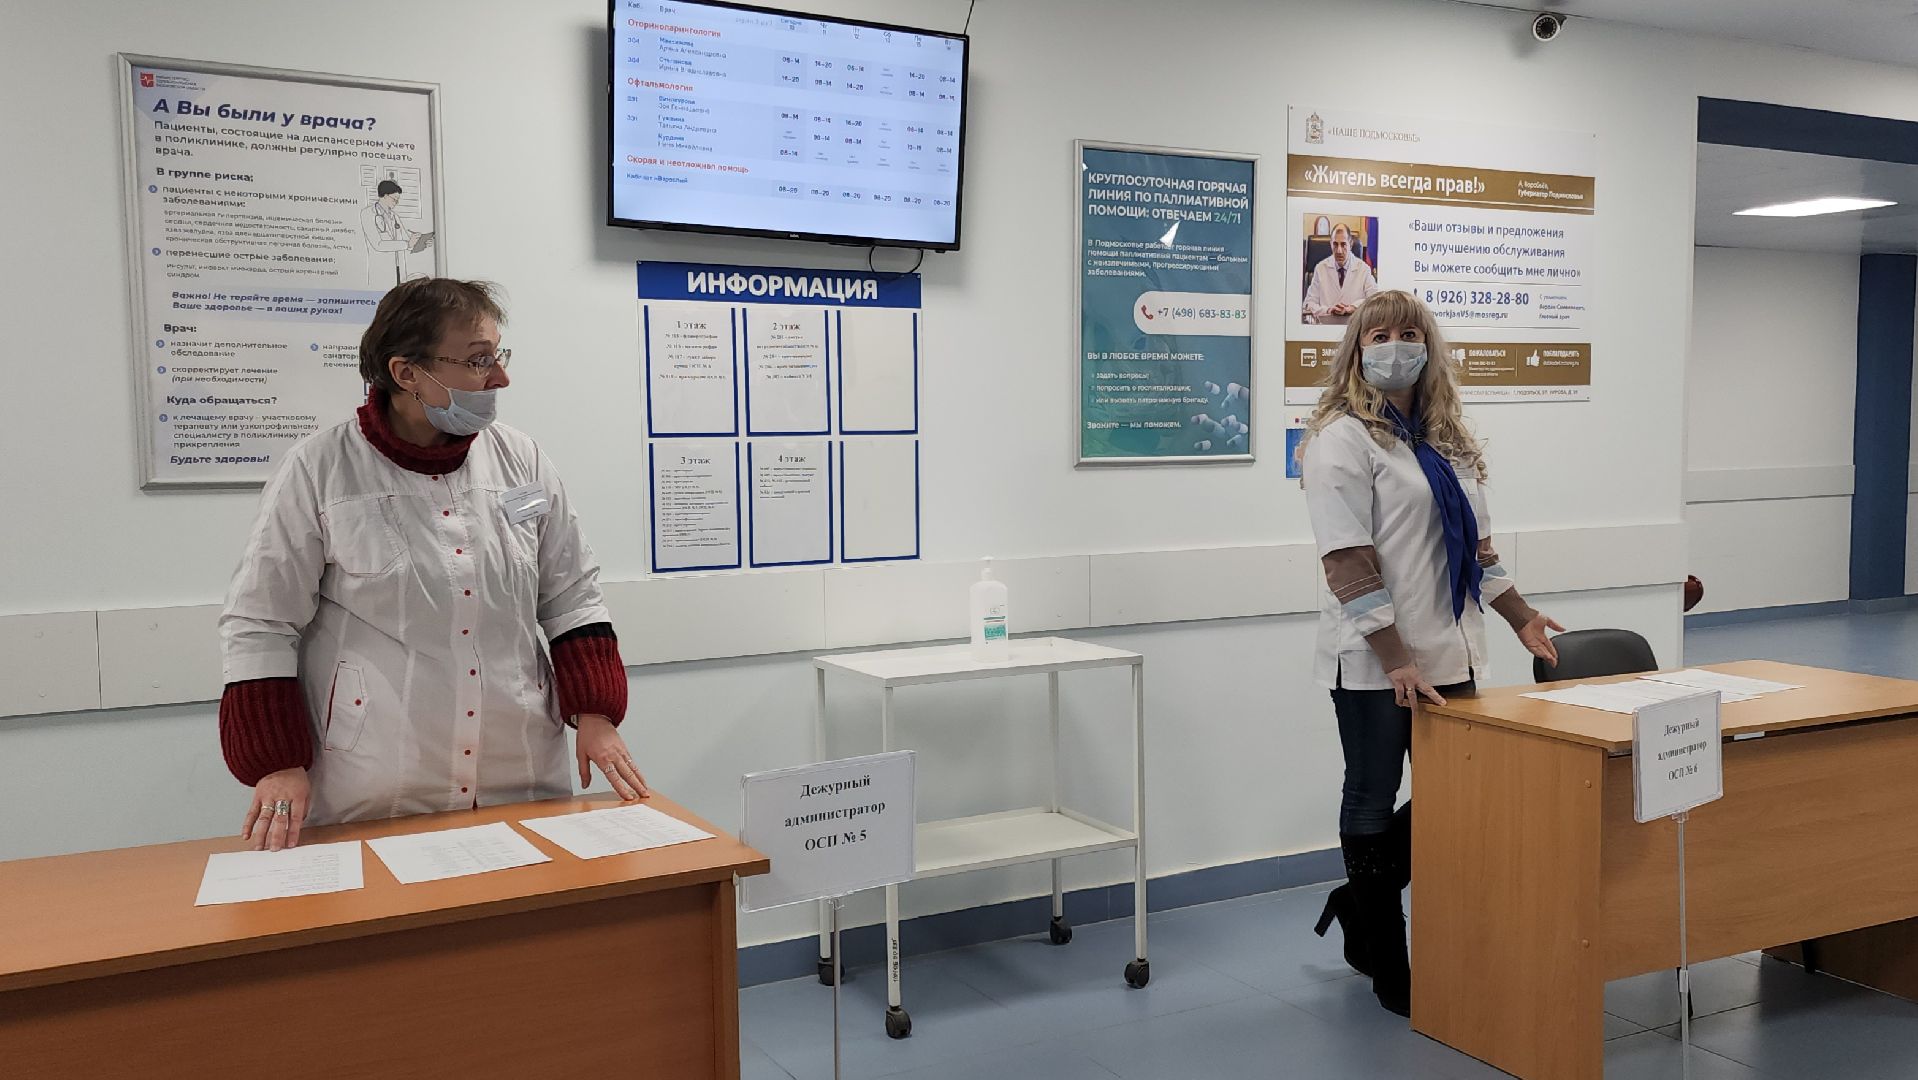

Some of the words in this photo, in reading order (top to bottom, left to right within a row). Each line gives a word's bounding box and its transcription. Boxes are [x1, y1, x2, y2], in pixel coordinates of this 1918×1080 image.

[628, 77, 693, 92] Офтальмология
[153, 99, 170, 114] А
[177, 101, 211, 117] Вы
[218, 104, 276, 123] были
[281, 113, 295, 127] у
[300, 114, 376, 131] врача?
[154, 121, 218, 135] Пациенты,
[221, 128, 283, 139] состоящие
[303, 135, 384, 148] диспансерном
[386, 142, 416, 151] учете
[1328, 127, 1358, 138] «НАШЕ
[1359, 129, 1421, 143] ПОДМОСКОВЬЕ»
[156, 147, 193, 157] врача.
[165, 135, 248, 150] поликлинике,
[251, 143, 297, 154] должны
[300, 146, 358, 158] регулярно
[361, 152, 413, 162] посещать
[627, 155, 657, 165] Скорая
[667, 160, 716, 171] неотложная
[718, 165, 749, 174] помощь
[156, 167, 165, 176] В
[168, 169, 211, 179] группе
[1305, 164, 1377, 187] «Житель
[1380, 173, 1432, 194] всегда
[1436, 176, 1485, 196] прав!»
[1088, 172, 1195, 191] КРУГЛОСУТОЧНАЯ
[1197, 180, 1247, 194] ГОРЯЧАЯ
[162, 186, 214, 195] пациенты
[224, 190, 286, 200] некоторыми
[288, 194, 358, 205] хроническими
[1088, 189, 1132, 201] ЛИНИЯ
[1135, 191, 1152, 203] ПО
[1153, 193, 1249, 210] ПАЛЛИАТИВНОЙ
[1088, 204, 1150, 219] ПОМОЩИ:
[1151, 208, 1212, 222] ОТВЕЧАЕМ
[1214, 211, 1241, 225] 24/7!
[1408, 219, 1443, 233] «Ваши
[1445, 223, 1485, 235] отзывы
[1487, 226, 1494, 235] и
[1496, 226, 1564, 239] предложения
[1094, 239, 1144, 249] Подмосковье
[1414, 243, 1428, 252] по
[1430, 244, 1491, 256] улучшению
[1493, 244, 1565, 259] обслуживания
[166, 249, 231, 259] перенесшие
[233, 253, 269, 261] острые
[1172, 253, 1209, 262] пациентам
[1216, 255, 1248, 263] больным
[1414, 260, 1429, 273] Вы
[1432, 265, 1471, 275] можете
[1473, 263, 1523, 278] сообщить
[1525, 267, 1545, 276] мне
[1547, 268, 1581, 279] лично»
[687, 272, 878, 303] ИНФОРМАЦИЯ
[172, 291, 211, 300] Важно!
[213, 293, 227, 301] Не
[230, 294, 270, 303] теряйте
[272, 296, 304, 304] время
[317, 298, 376, 306] запишитесь
[1426, 290, 1433, 303] 8
[1436, 290, 1467, 306] (926)
[1470, 291, 1529, 306] 328-28-80
[172, 302, 202, 310] Ваше
[204, 304, 253, 312] здоровье
[310, 308, 343, 316] руках!
[1158, 307, 1169, 317] +7
[1172, 307, 1196, 320] (498)
[1199, 309, 1247, 320] 683-83-83
[163, 324, 197, 334] Врач:
[676, 321, 681, 329] 1
[683, 322, 707, 330] этаж
[170, 349, 236, 357] обследование
[214, 342, 288, 350] дополнительное
[1087, 352, 1101, 360] ВЫ
[1102, 352, 1107, 360] В
[1108, 352, 1140, 361] ЛЮБОЕ
[1141, 353, 1170, 361] ВРЕМЯ
[1171, 353, 1205, 361] МОЖЕТЕ:
[172, 375, 193, 384] (при
[195, 376, 268, 385] необходимости)
[1096, 372, 1118, 380] задать
[166, 395, 197, 406] Куда
[199, 395, 277, 406] обращаться?
[239, 423, 319, 431] узкопрофильному
[1087, 421, 1120, 429] Звоните
[1143, 421, 1182, 429] поможем.
[170, 455, 211, 465] Будьте
[215, 455, 270, 464] здоровы!
[688, 457, 711, 465] этаж
[1664, 718, 1700, 737] Дежурный
[1658, 741, 1707, 761] администратор
[1668, 767, 1684, 781] ОСП
[1685, 765, 1693, 775] №
[1694, 763, 1698, 773] 6
[800, 775, 871, 799] Дежурный
[784, 802, 886, 827] администратор
[805, 834, 837, 851] ОСП
[842, 832, 856, 845] №
[860, 830, 867, 841] 5
